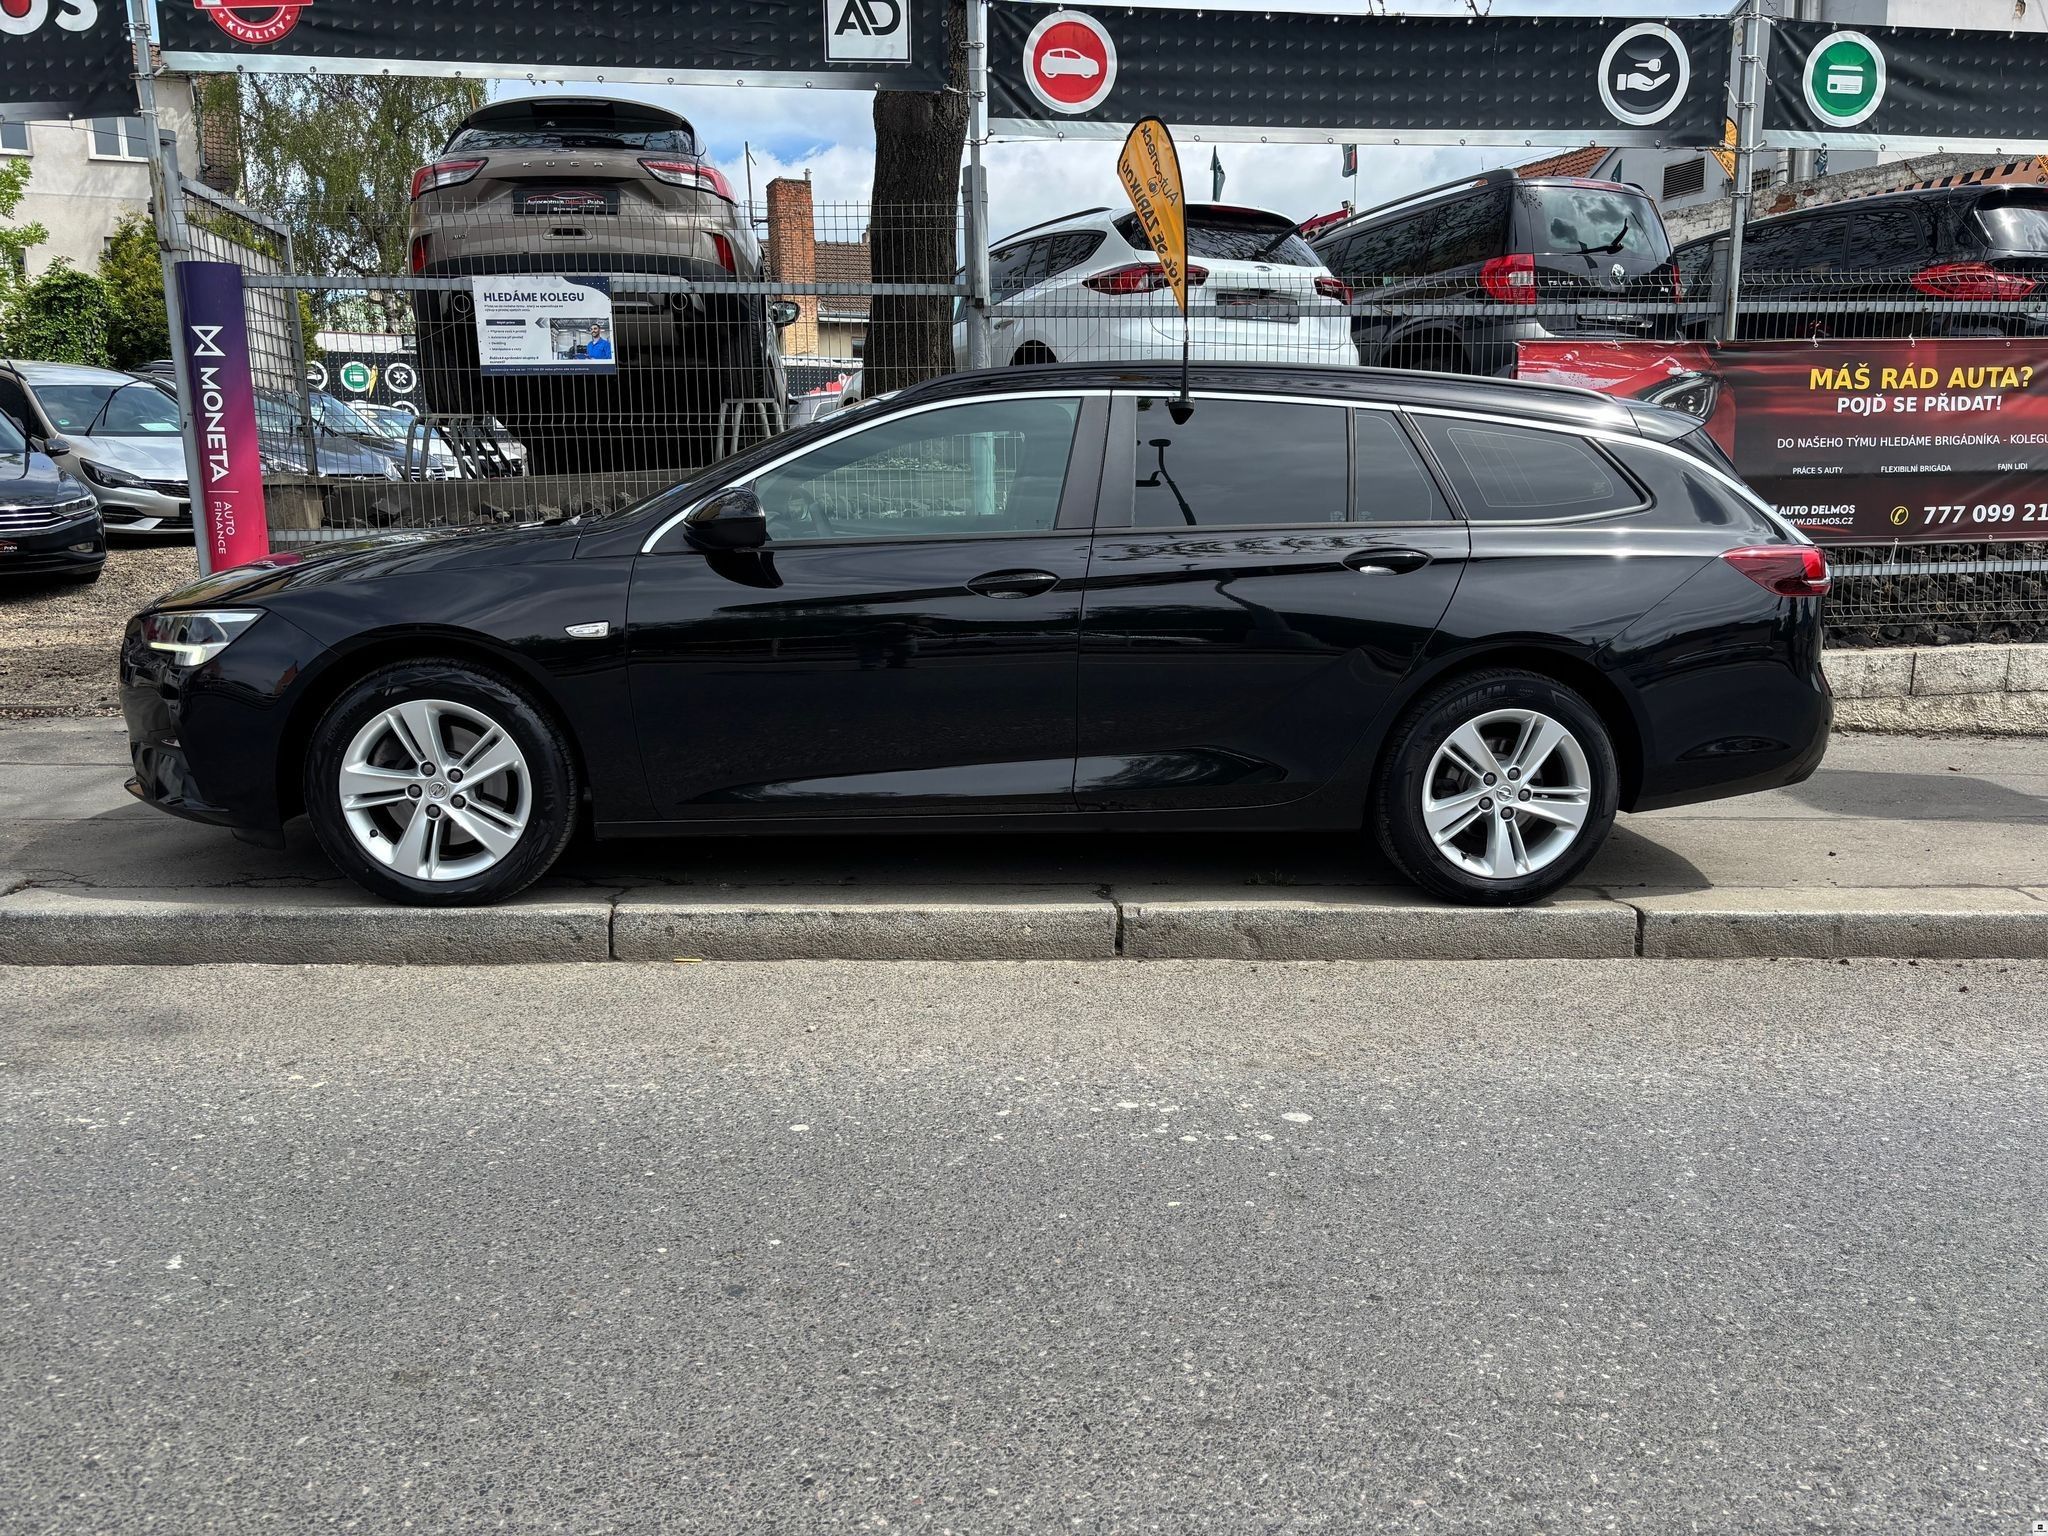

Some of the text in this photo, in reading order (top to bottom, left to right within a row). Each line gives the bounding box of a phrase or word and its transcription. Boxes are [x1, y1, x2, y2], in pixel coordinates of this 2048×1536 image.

[226, 20, 286, 39] KVALITY
[483, 290, 585, 302] HLEDÁME KOLEGU
[1809, 362, 2034, 390] MÁŠ RÁD AUTA?
[1836, 392, 2003, 417] POJĎ SE PŘIDAT!
[200, 367, 230, 483] MONETA
[1777, 438, 1795, 449] DO
[1797, 435, 1844, 448] NAŠEHO
[1846, 434, 1878, 448] TÝMU
[1880, 433, 1932, 447] HLEDÁME
[1934, 432, 2000, 447] BRIGÁDNÍKA
[1792, 465, 1844, 475] PRÁCE S AUTY
[1880, 463, 1951, 473] FLEXIBILNÍ BRIGÁDA
[1997, 462, 2028, 472] FAJN LIDI
[223, 501, 235, 536] AUTO
[1779, 504, 1856, 515] AUTO DELMOS
[1923, 503, 2048, 525] 777 099 21
[213, 501, 227, 555] FINANCE
[1440, 684, 1507, 721] ICHELIN
